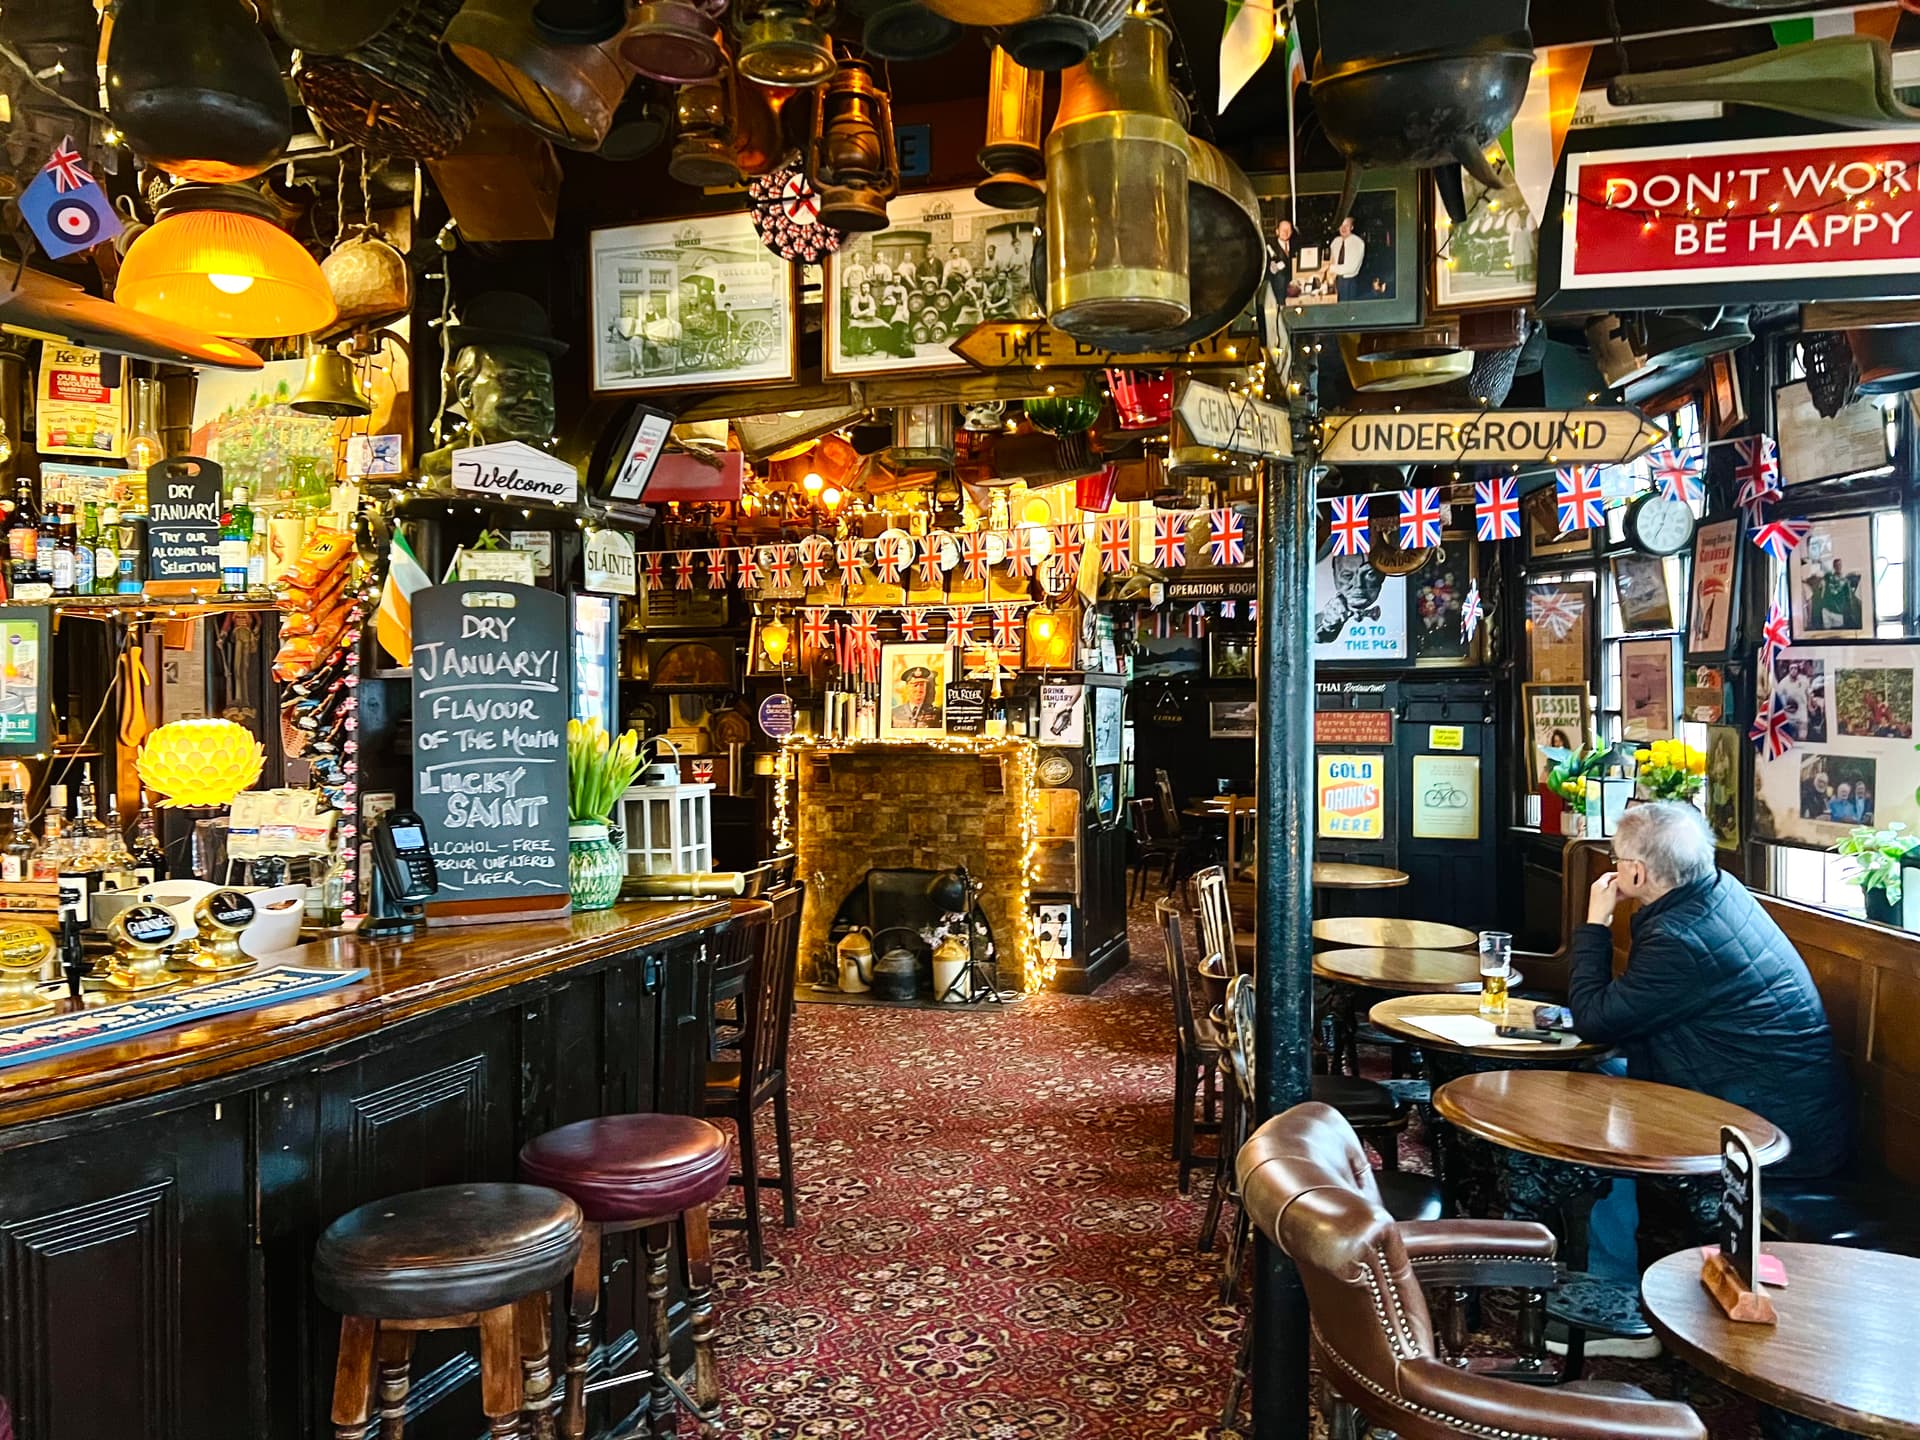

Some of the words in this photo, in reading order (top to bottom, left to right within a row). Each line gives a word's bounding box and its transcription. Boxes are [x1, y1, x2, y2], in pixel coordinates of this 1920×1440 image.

[1605, 168, 1770, 209] DON'T
[1783, 159, 1920, 198] WOR
[1674, 221, 1727, 255] BE
[1748, 210, 1913, 250] HAPPY
[995, 331, 1052, 358] THE
[1350, 418, 1608, 452] UNDERGROUND
[168, 484, 195, 499] DRY
[458, 462, 572, 495] Welcome
[151, 490, 220, 522] JANUARY!
[158, 532, 181, 543] TRY
[186, 532, 208, 543] OUR
[152, 546, 199, 558] ALCOHOL
[587, 547, 633, 577] SLÁINTE
[160, 559, 217, 575] SELECTION
[1169, 583, 1224, 596] OPERATIONS
[461, 614, 516, 642] DRY
[1350, 626, 1366, 636] GO
[1369, 626, 1386, 636] TO
[1345, 640, 1369, 650] THE
[413, 641, 559, 683] JANUARY!
[1315, 683, 1340, 692] THAI
[432, 696, 541, 722] FLAVOUR
[1535, 698, 1578, 715] JESSIE
[418, 730, 449, 750] OF
[452, 729, 497, 752] THE
[502, 726, 559, 755] MONTH
[420, 766, 527, 798] LUCKY
[1330, 763, 1372, 778] COLD
[444, 792, 549, 828] SAINT
[1325, 784, 1376, 812] DRINKS
[1329, 817, 1372, 832] HERE
[483, 855, 556, 870] UNFILTERED
[464, 871, 522, 885] LAGER
